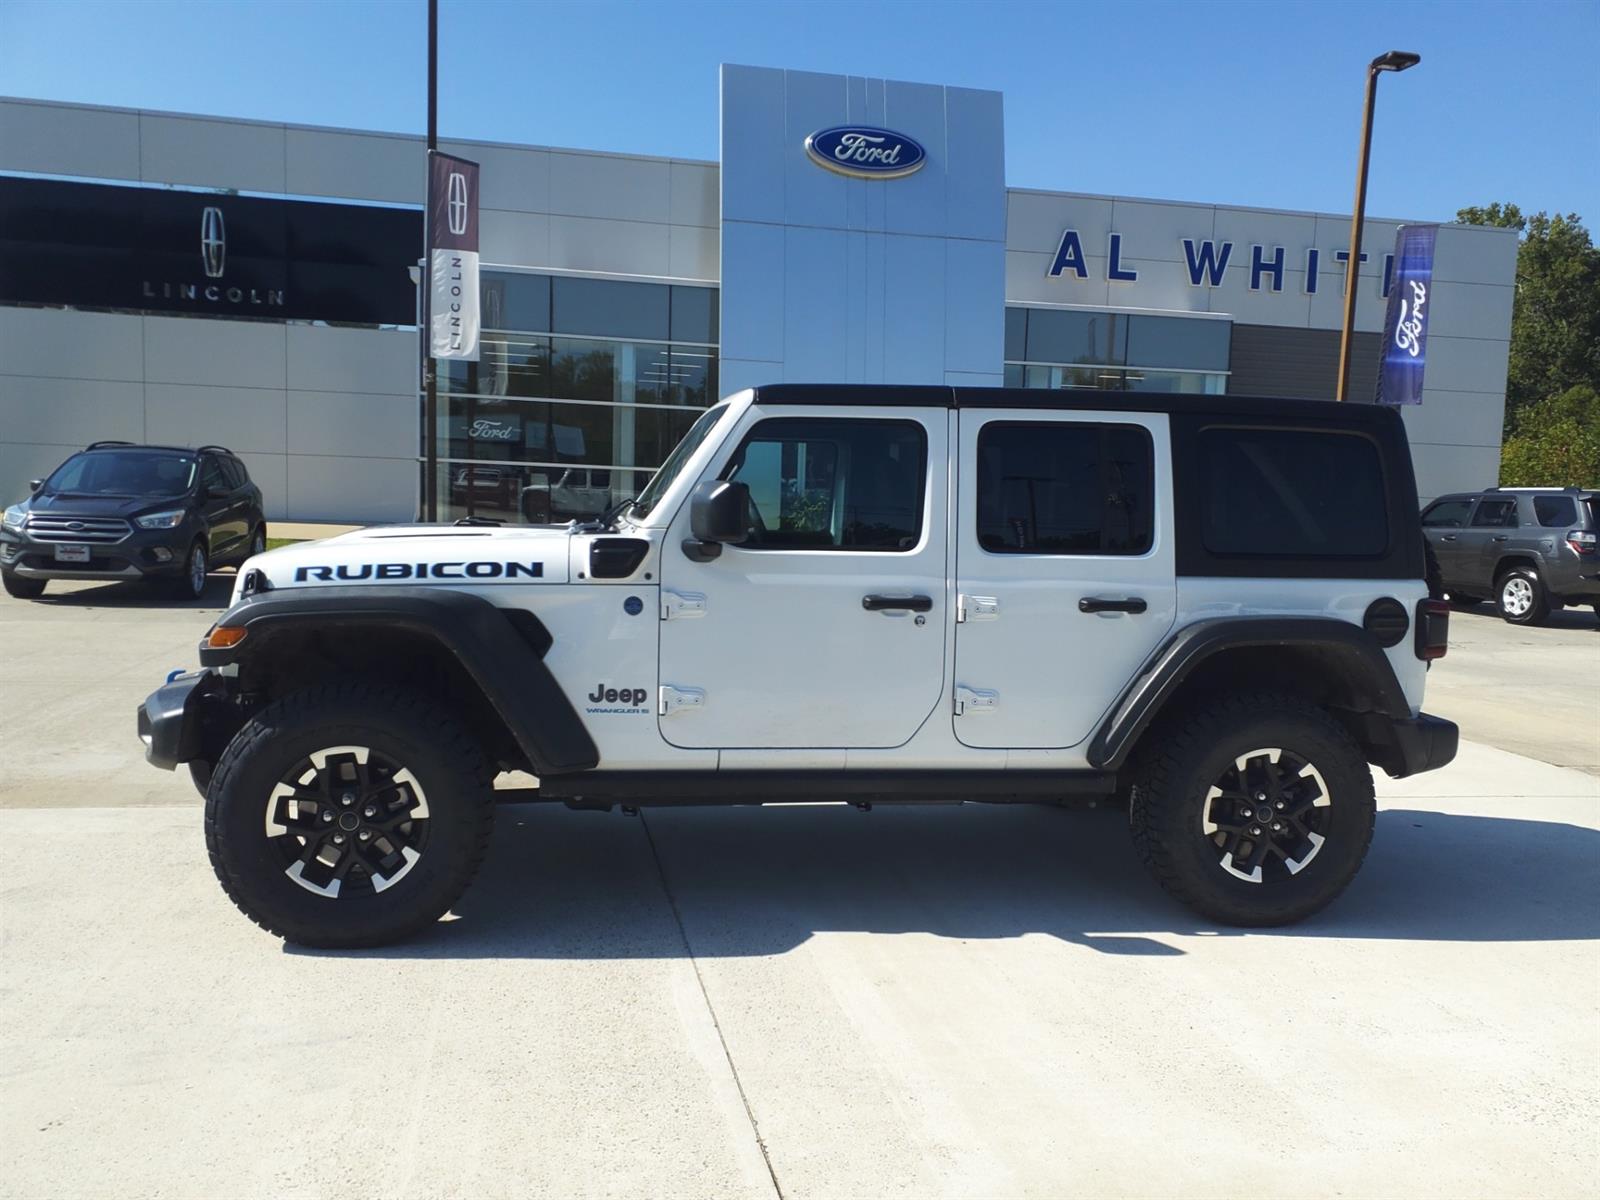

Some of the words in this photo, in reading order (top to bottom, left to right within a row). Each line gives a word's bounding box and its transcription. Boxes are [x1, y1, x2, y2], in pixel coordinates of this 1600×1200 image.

[835, 133, 902, 164] Ford
[1048, 229, 1138, 282] AL
[1180, 238, 1396, 299] WHI
[143, 281, 284, 305] LINCOLN
[450, 257, 463, 351] LINCOLN
[1395, 280, 1426, 357] Ford
[468, 419, 513, 439] Ford
[294, 561, 545, 582] RUBICON
[588, 683, 648, 707] Jeep
